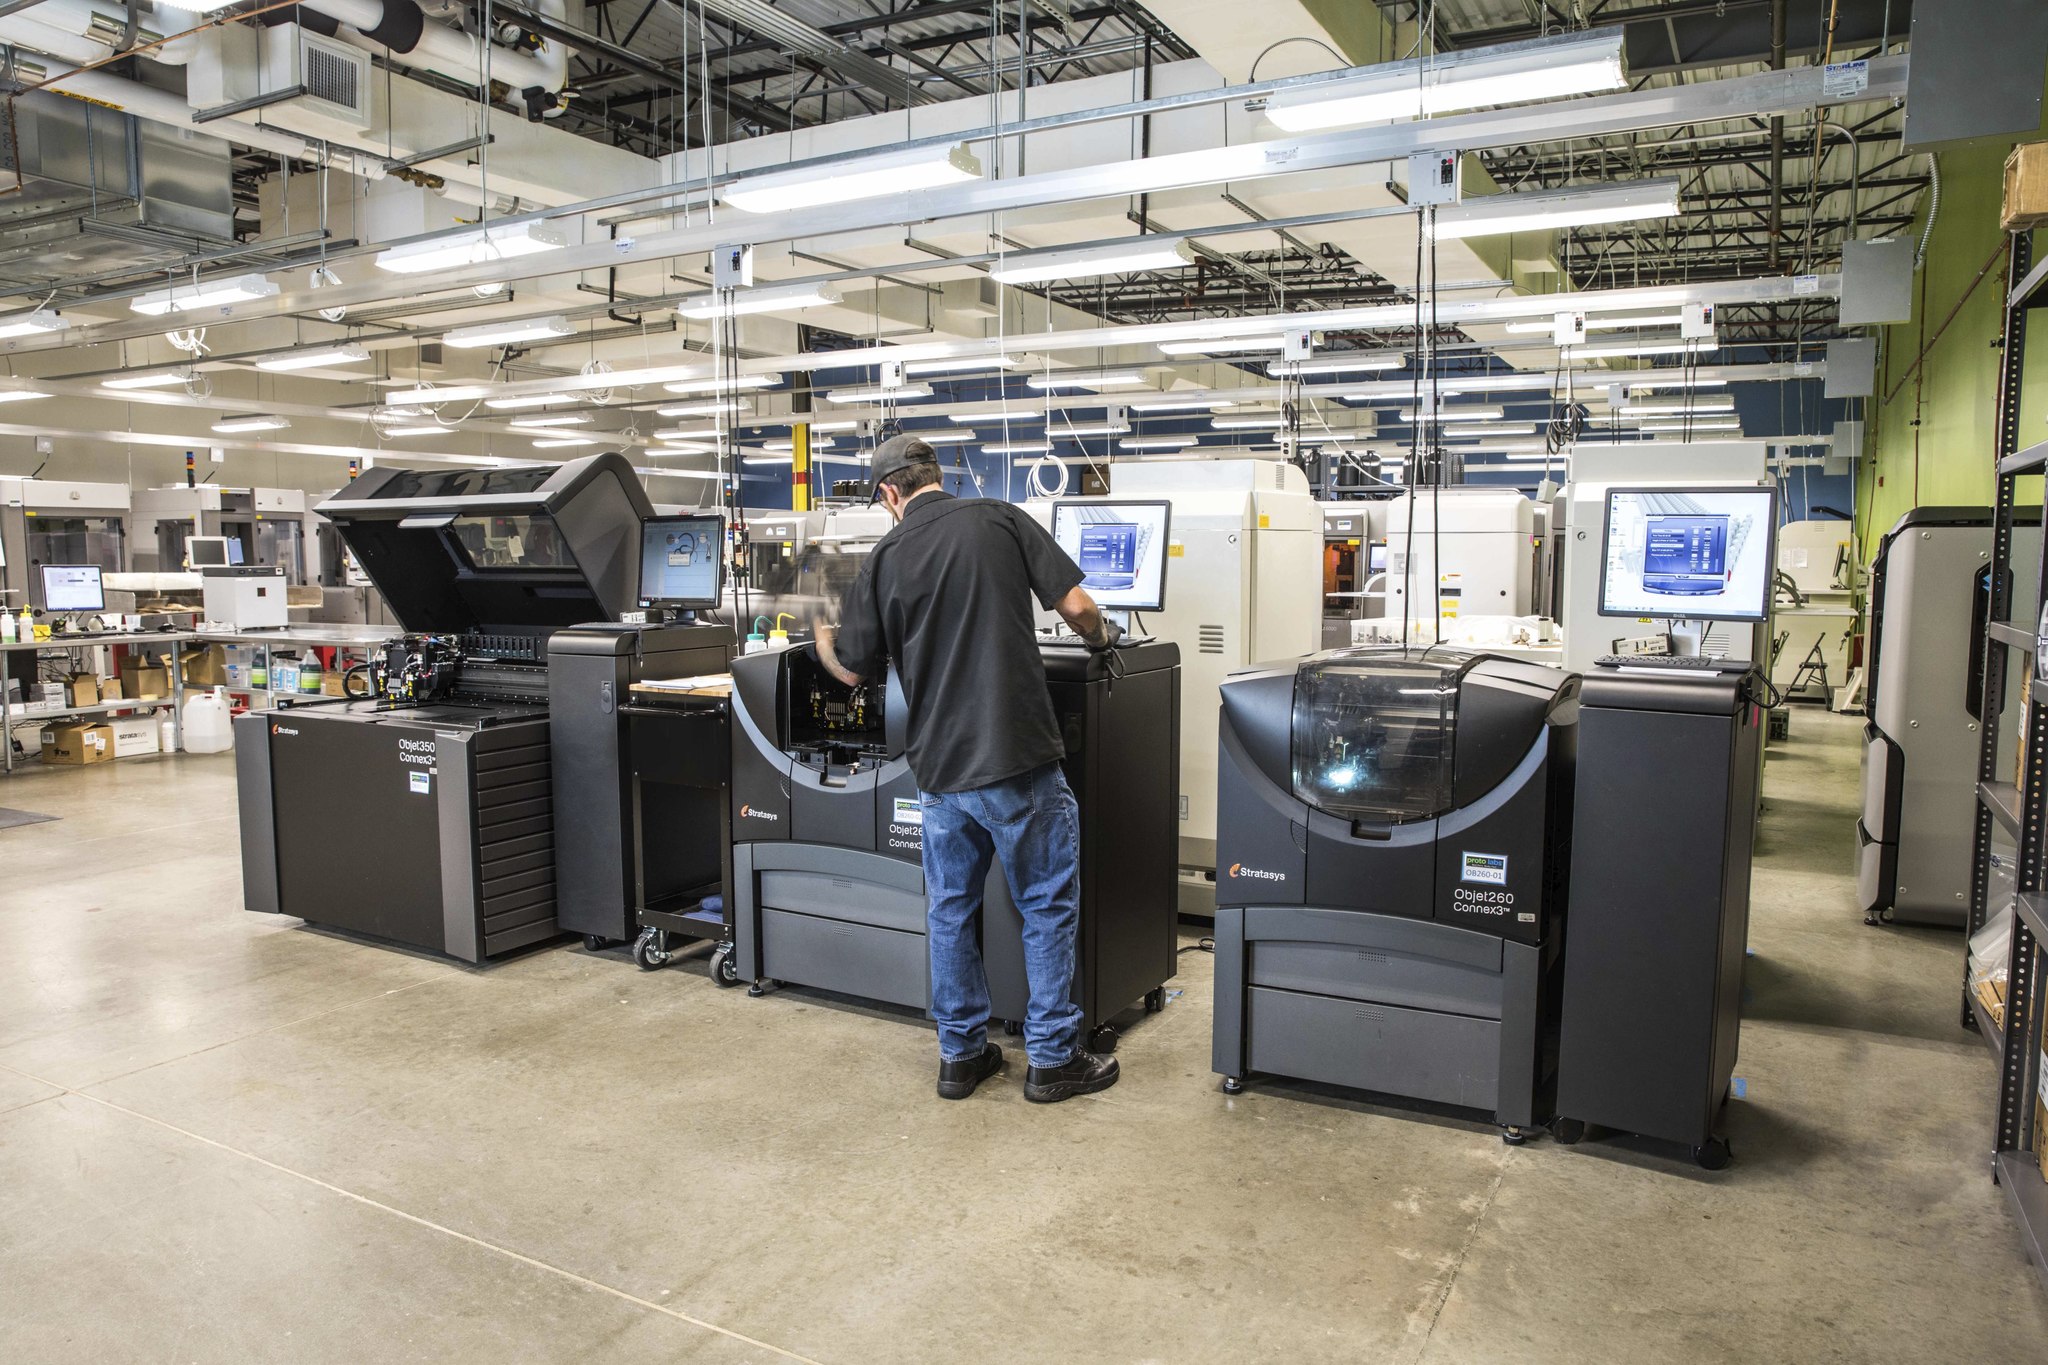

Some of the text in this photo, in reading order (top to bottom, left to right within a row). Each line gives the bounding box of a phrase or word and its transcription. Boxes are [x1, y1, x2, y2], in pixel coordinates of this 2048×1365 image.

[399, 739, 435, 753] Objet350
[748, 808, 778, 821] Stratasys
[1467, 857, 1487, 865] proto
[1240, 867, 1286, 881] Stratasys
[1465, 869, 1502, 880] OB260-01
[1454, 888, 1514, 904] Objet260
